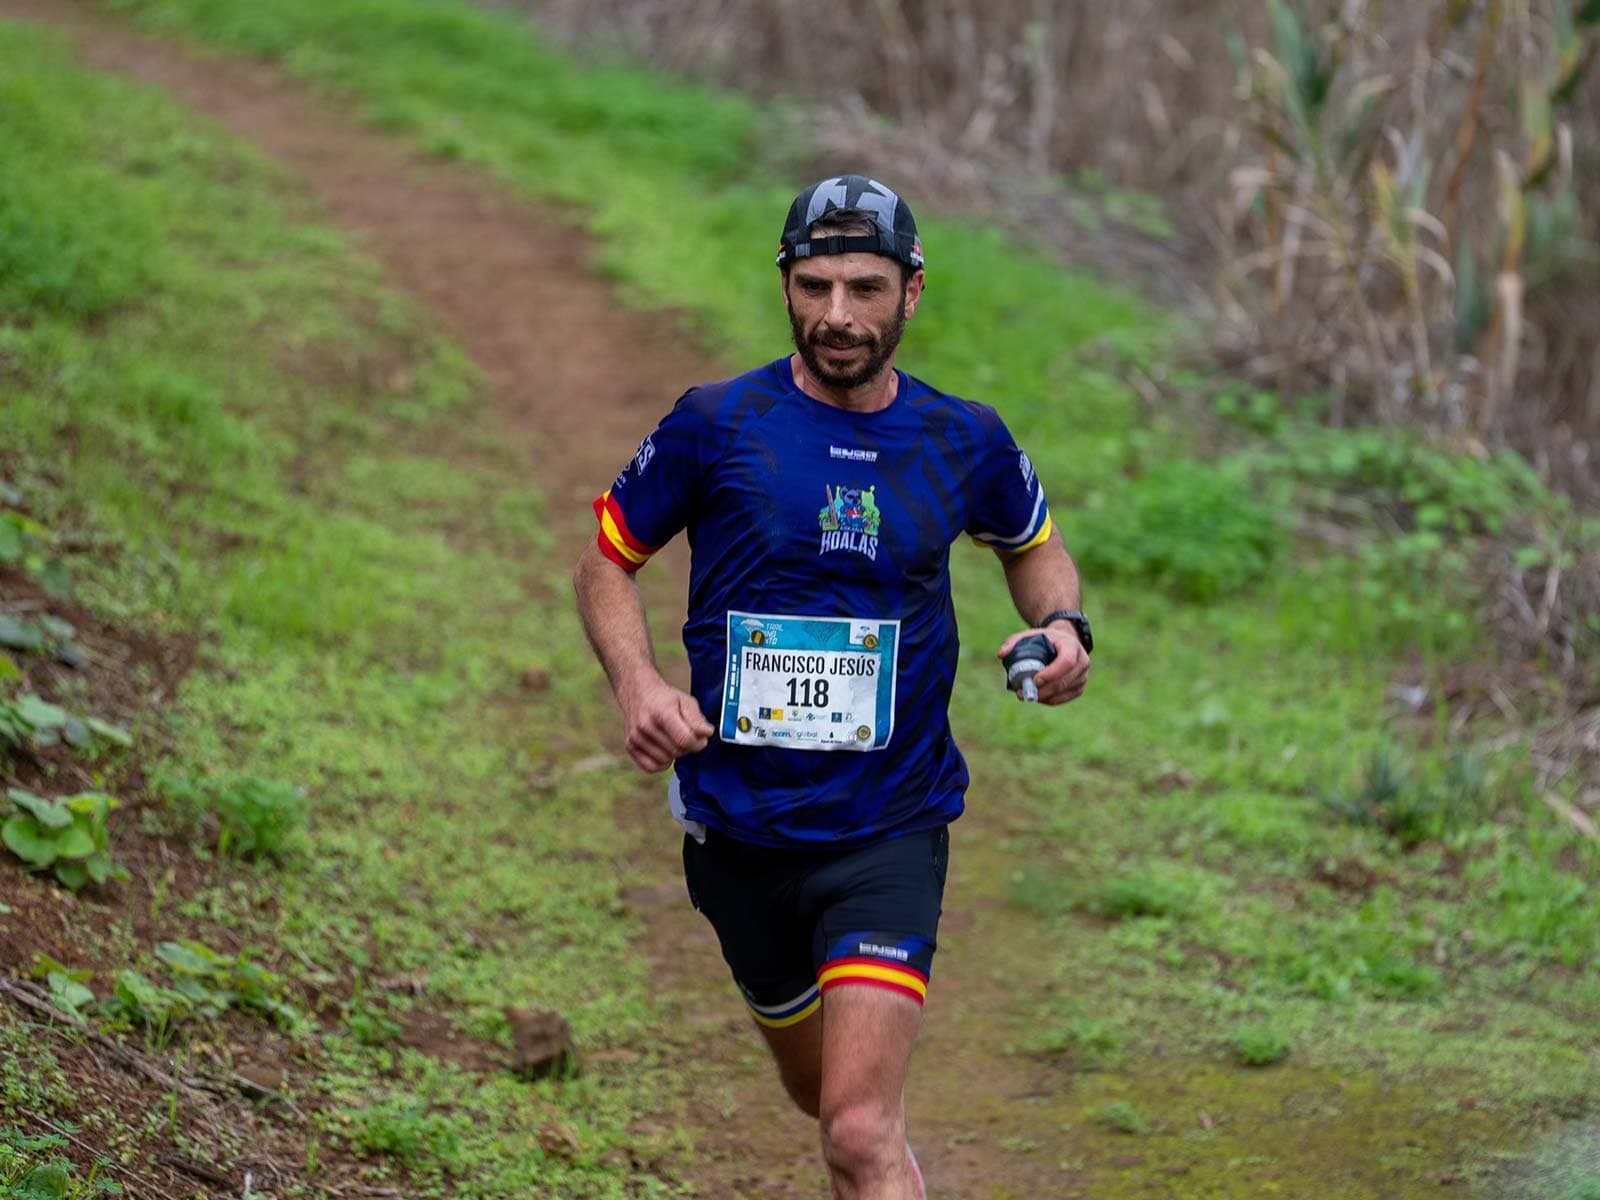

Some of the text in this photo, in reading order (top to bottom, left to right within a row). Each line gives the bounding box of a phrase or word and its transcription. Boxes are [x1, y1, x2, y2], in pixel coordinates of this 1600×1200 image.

[819, 530, 878, 561] KOALAS
[745, 651, 875, 676] FRANCISCO JESÚS
[786, 677, 830, 708] 118
